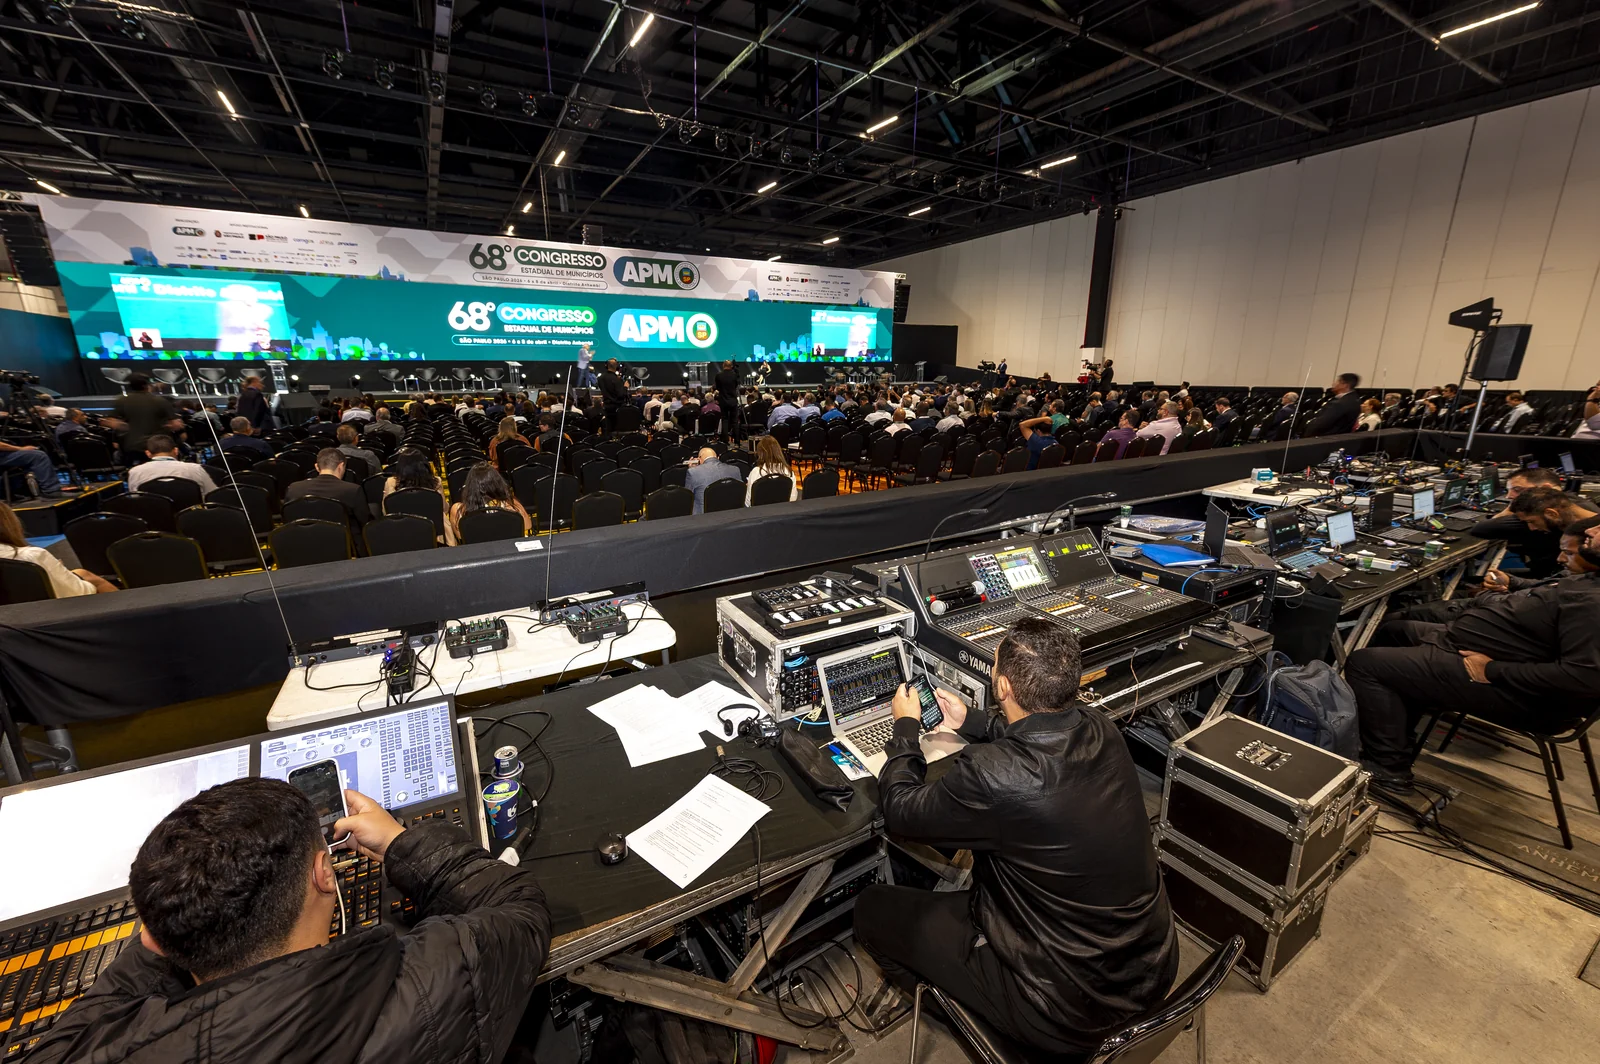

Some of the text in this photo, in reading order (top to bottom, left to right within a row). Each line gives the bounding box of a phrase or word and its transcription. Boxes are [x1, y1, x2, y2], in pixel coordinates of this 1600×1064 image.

[176, 227, 195, 235] APM
[517, 249, 604, 268] CONGRESSO
[521, 267, 604, 279] ESTADUAL DE MUNICÍPIOS
[621, 261, 674, 285] APM
[500, 306, 594, 323] CONGRESSO
[504, 324, 594, 335] ESTADUAL DE MUNICÍPIOS
[618, 313, 685, 343] APM
[459, 336, 472, 344] SÃO
[969, 655, 991, 677] YAMA
[1517, 845, 1600, 882] ANHEM
